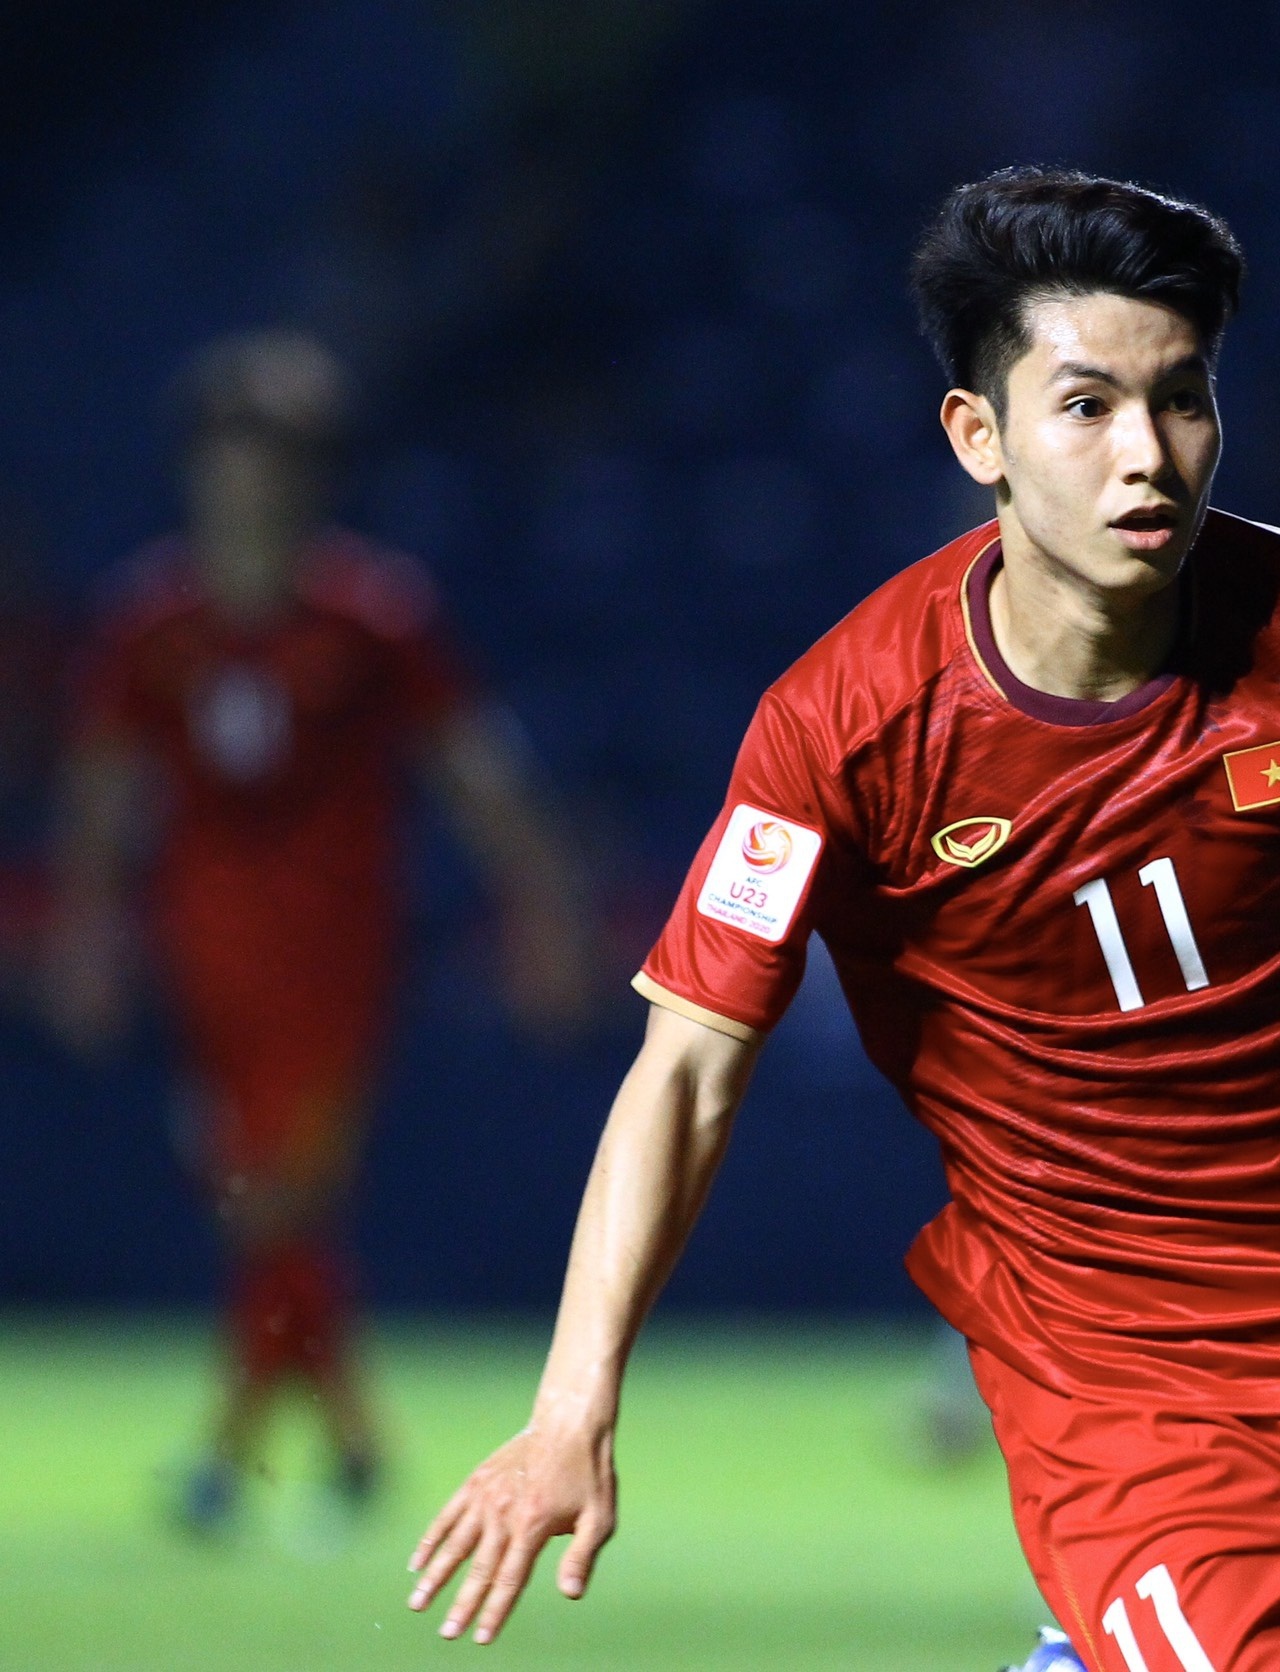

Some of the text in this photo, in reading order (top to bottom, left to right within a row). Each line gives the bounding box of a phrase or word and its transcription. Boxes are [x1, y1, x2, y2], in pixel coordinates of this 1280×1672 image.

[730, 882, 768, 908] U23
[746, 877, 763, 887] AFC
[707, 903, 747, 924] THAILAND
[708, 893, 777, 923] CHAMPIONSHIP
[1073, 857, 1210, 1012] 11
[1102, 1563, 1216, 1672] 11
